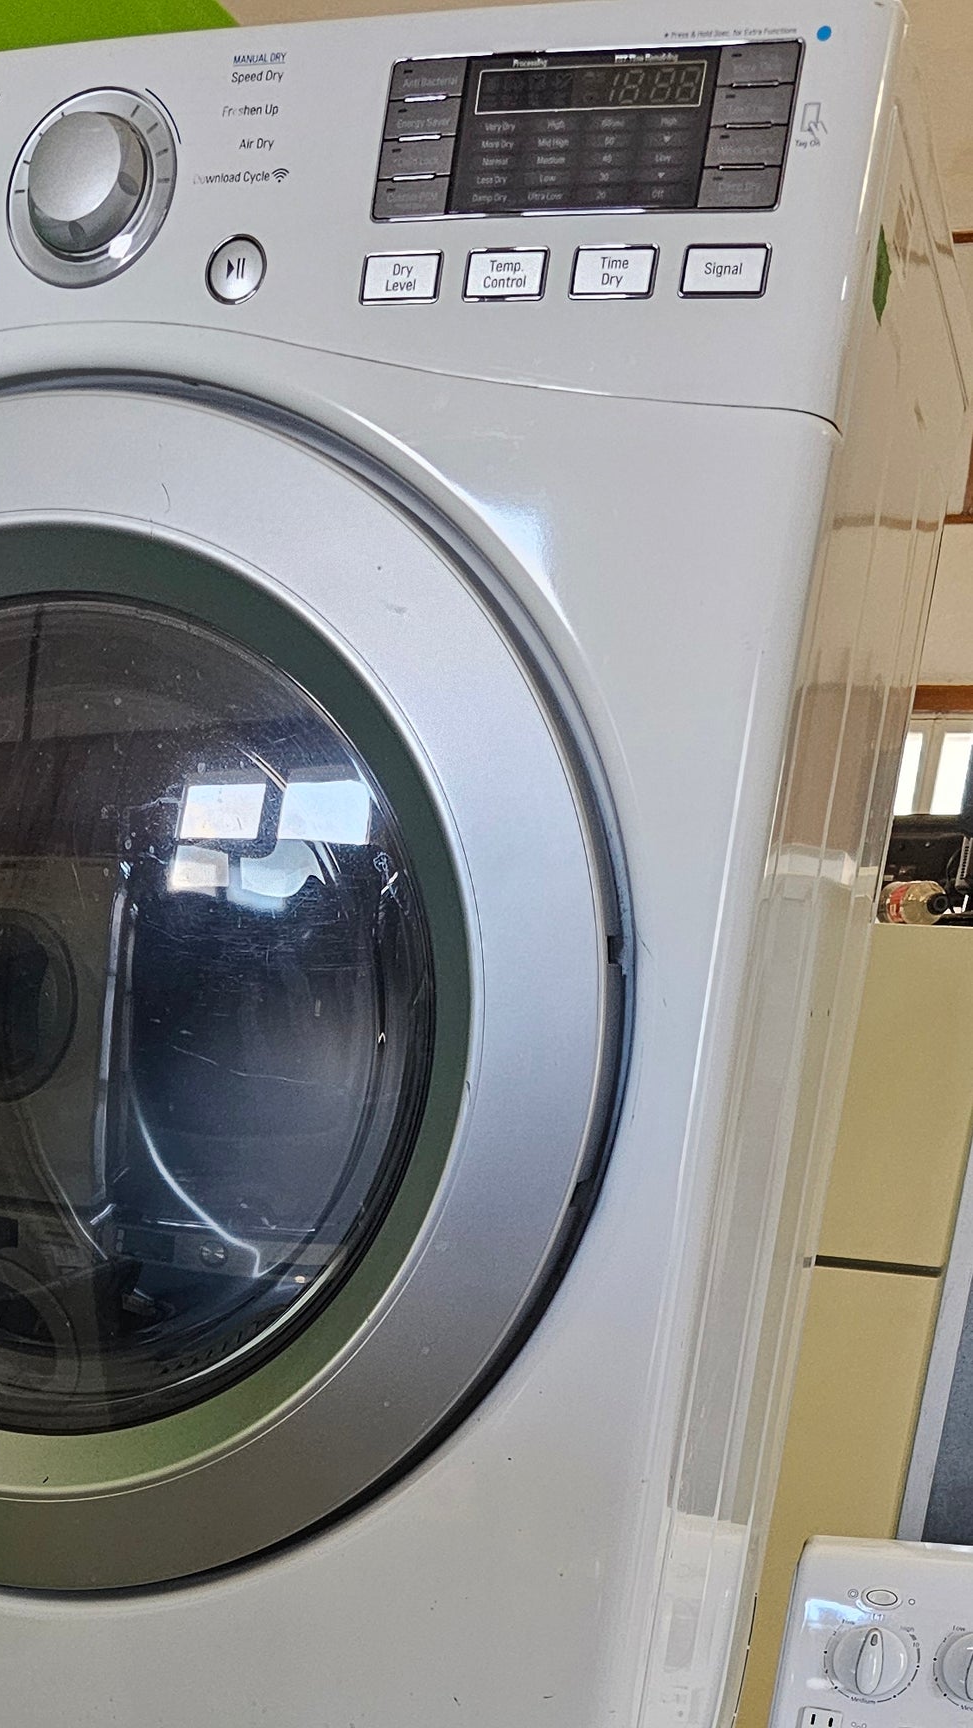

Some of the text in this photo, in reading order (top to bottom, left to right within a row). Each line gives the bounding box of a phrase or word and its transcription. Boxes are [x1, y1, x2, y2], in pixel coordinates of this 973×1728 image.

[744, 28, 762, 36] Extra
[763, 27, 797, 35] Functions
[233, 52, 287, 64] MANUAL DRY
[231, 70, 284, 84] Speed Dry
[265, 104, 279, 116] Up
[239, 138, 274, 151] Air Dry
[501, 139, 514, 150] Dry
[243, 170, 270, 184] Cycle
[493, 175, 507, 185] Dry
[492, 193, 507, 203] Dry
[490, 259, 524, 276] Temp.
[601, 256, 629, 270] Time
[704, 261, 742, 277] Signal
[393, 263, 413, 278] Dry
[385, 278, 416, 292] Level
[483, 274, 526, 289] Control
[601, 273, 623, 288] Dry
